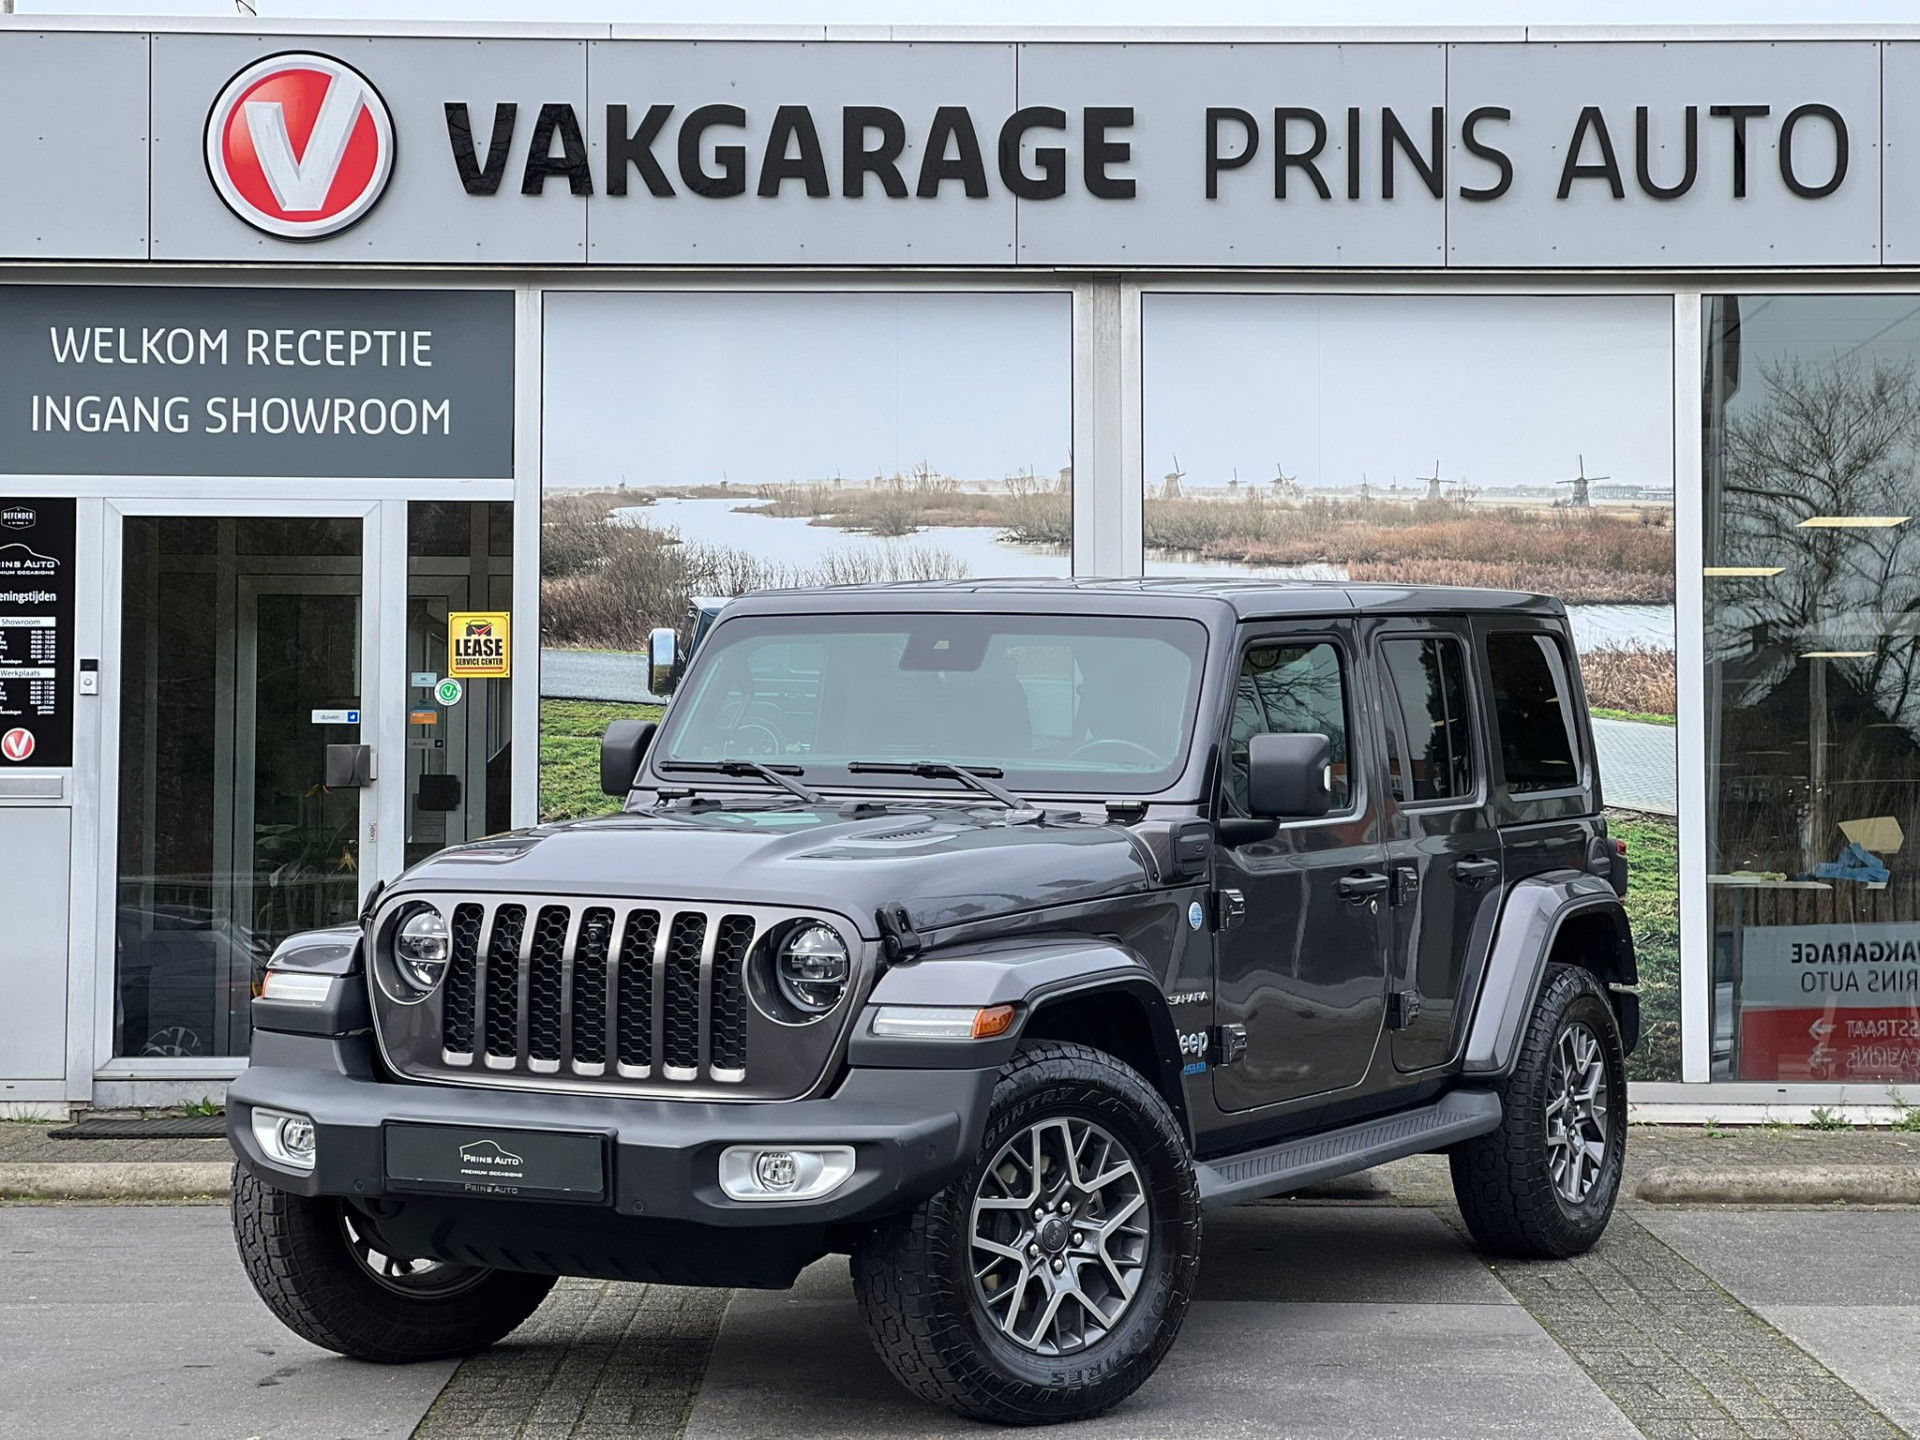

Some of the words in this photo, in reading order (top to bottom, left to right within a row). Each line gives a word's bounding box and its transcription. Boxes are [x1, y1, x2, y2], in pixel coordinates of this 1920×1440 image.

[444, 102, 1136, 200] VAKGARAGE
[1206, 106, 1514, 200] PRINS
[1556, 103, 1849, 200] AUTO
[50, 326, 228, 365] WELKOM
[247, 329, 433, 367] RECEPTIE
[31, 394, 190, 434] INGANG
[205, 396, 450, 435] SHOWROOM
[0, 560, 21, 568] INS
[23, 560, 55, 568] AUTO
[455, 638, 503, 657] LEASE
[455, 658, 480, 666] SERVICE
[481, 658, 503, 666] CENTER
[0, 670, 41, 679] Werkplaats
[1167, 991, 1208, 1005] SAHARA
[463, 1153, 492, 1164] PRINS
[494, 1156, 519, 1166] AUTO
[464, 1183, 492, 1193] PRINS
[494, 1186, 518, 1195] AUTO
